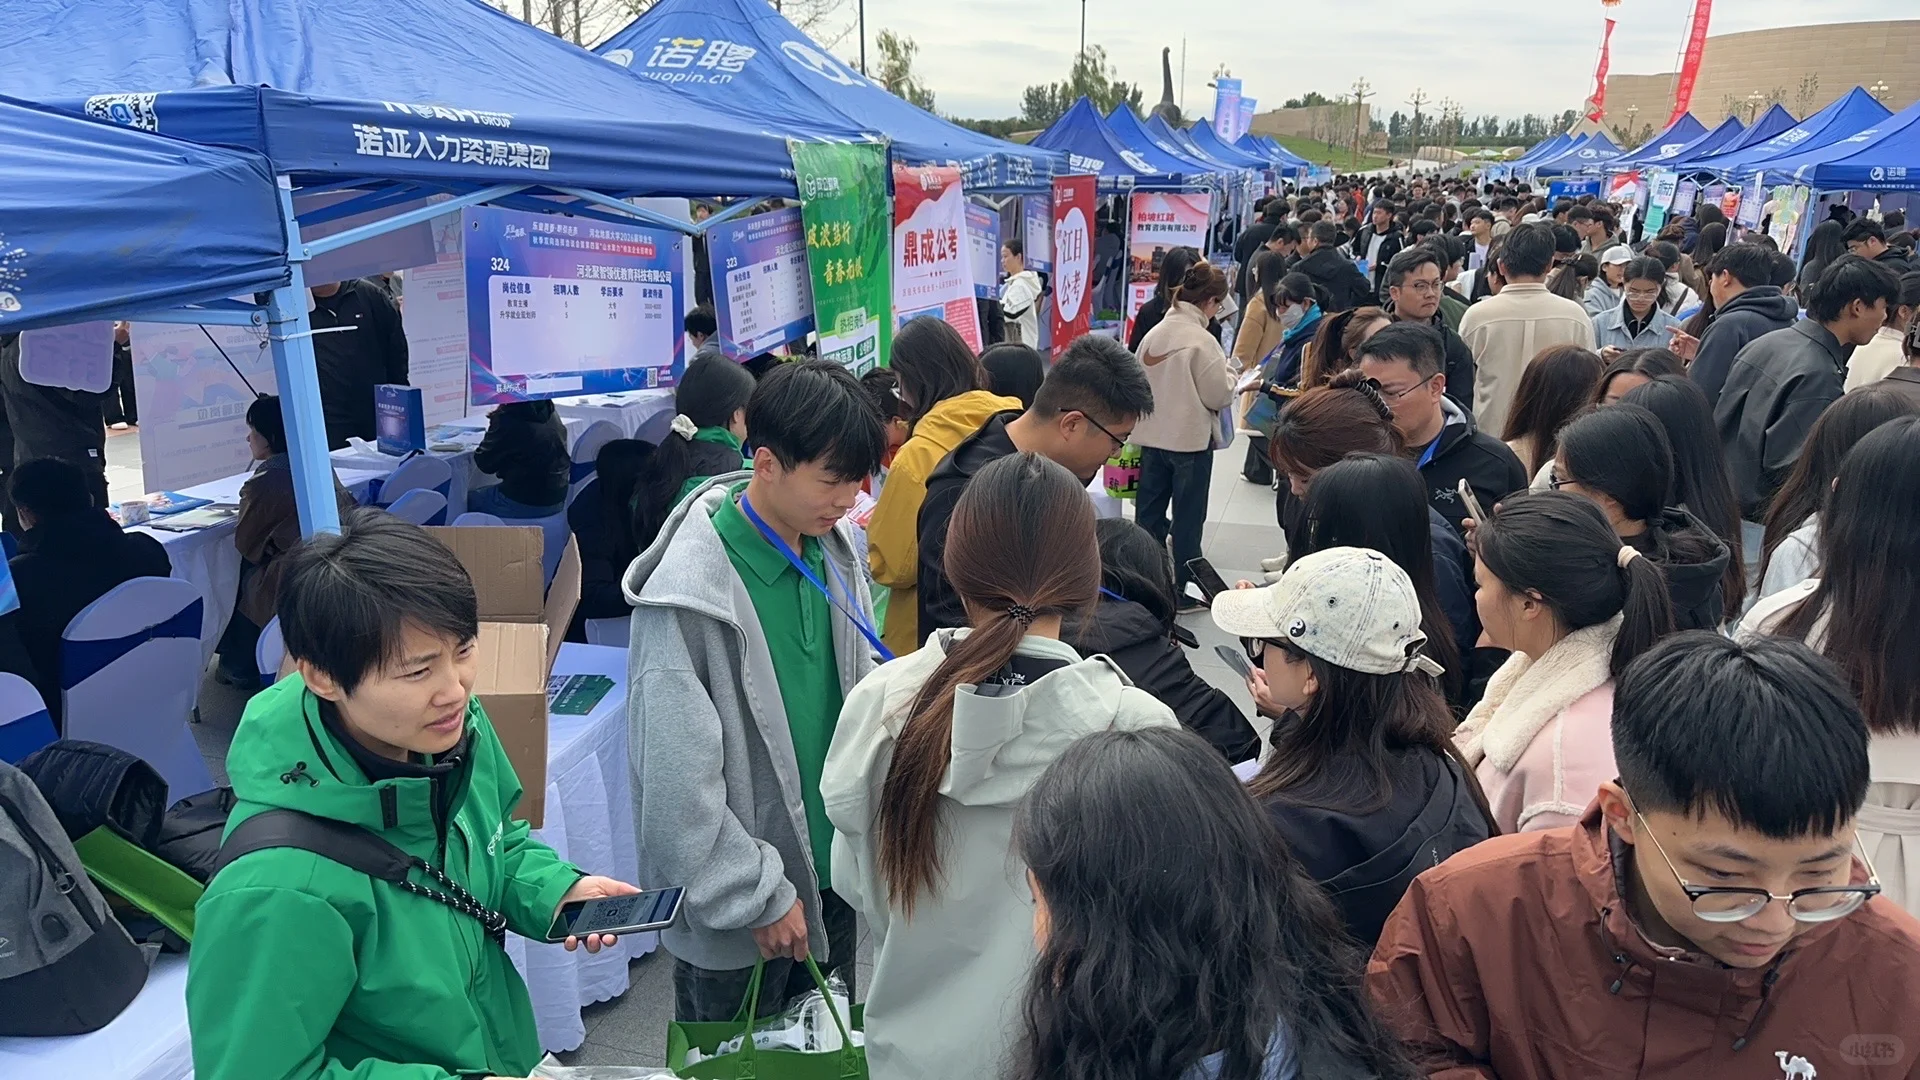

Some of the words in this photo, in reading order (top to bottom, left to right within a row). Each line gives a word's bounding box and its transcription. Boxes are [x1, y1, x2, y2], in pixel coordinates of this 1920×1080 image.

[646, 37, 758, 73] 诺聘
[480, 115, 511, 128] GROUP
[352, 123, 550, 170] 诺亚人力资源集团
[947, 153, 998, 189] 好工作
[1887, 166, 1906, 177] 诺聘
[1137, 212, 1175, 222] 柏坡红路
[1137, 223, 1197, 232] 教育咨询有限公司
[903, 227, 958, 268] 鼎成公考
[490, 257, 510, 271] 324
[726, 256, 738, 269] 323
[502, 282, 532, 294] 岗位信息
[553, 284, 580, 296] 招聘人数
[600, 286, 624, 297] 学历要求
[642, 288, 663, 299] 薪资待遇
[1061, 269, 1082, 307] 公考
[507, 299, 528, 308] 教育主播
